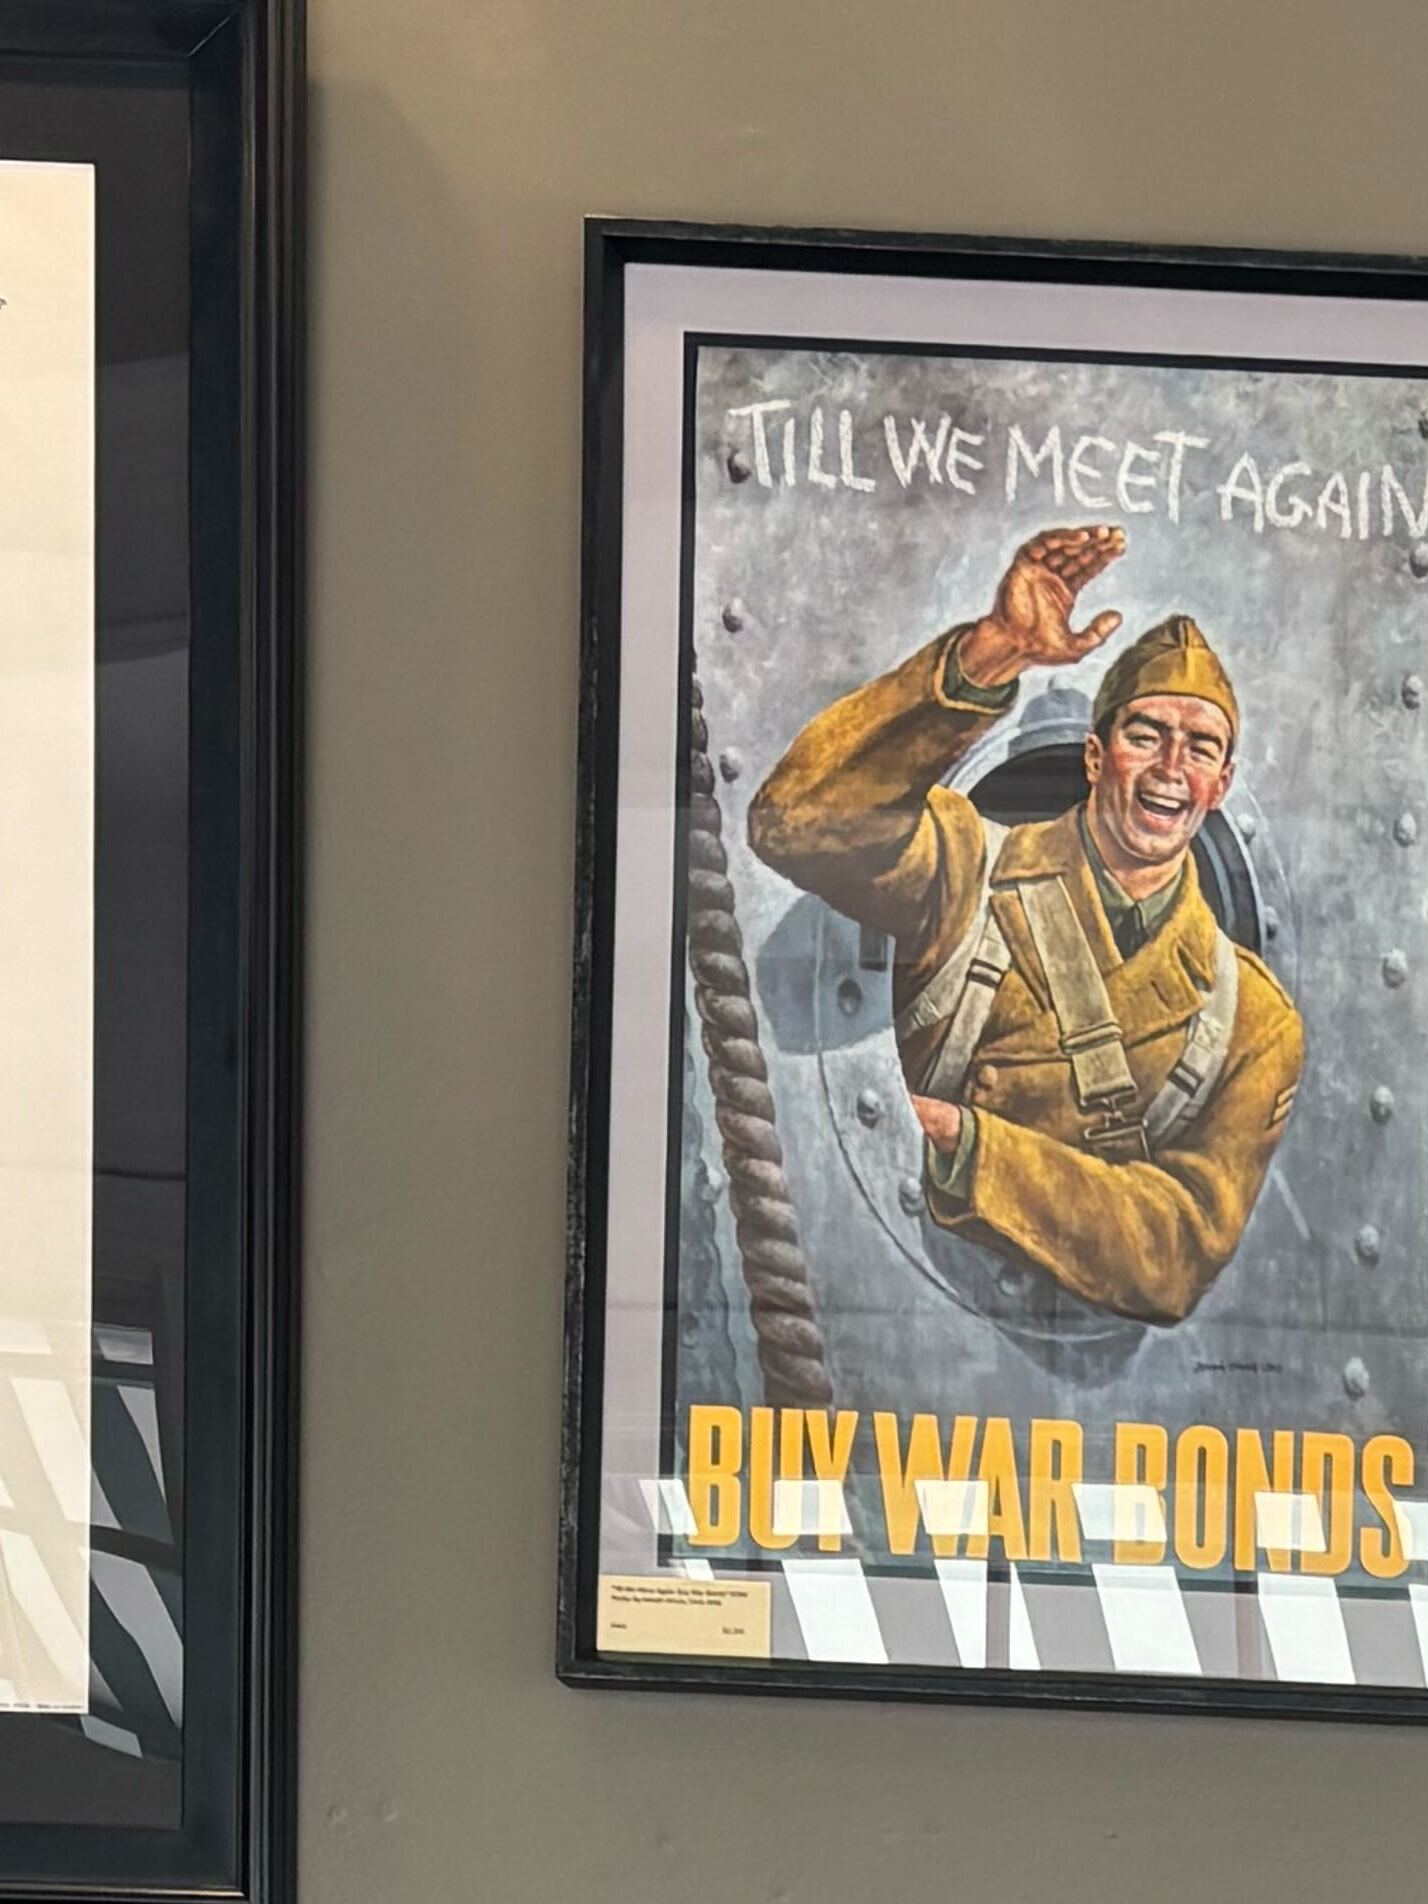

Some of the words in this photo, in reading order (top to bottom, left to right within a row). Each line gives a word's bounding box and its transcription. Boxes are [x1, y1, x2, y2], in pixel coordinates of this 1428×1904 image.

[728, 399, 877, 494] TILL
[884, 411, 986, 496] WE
[1005, 425, 1209, 525] MEET
[687, 1405, 858, 1552] BUY
[873, 1411, 1084, 1564] WAR
[1113, 1421, 1416, 1578] BONDS
